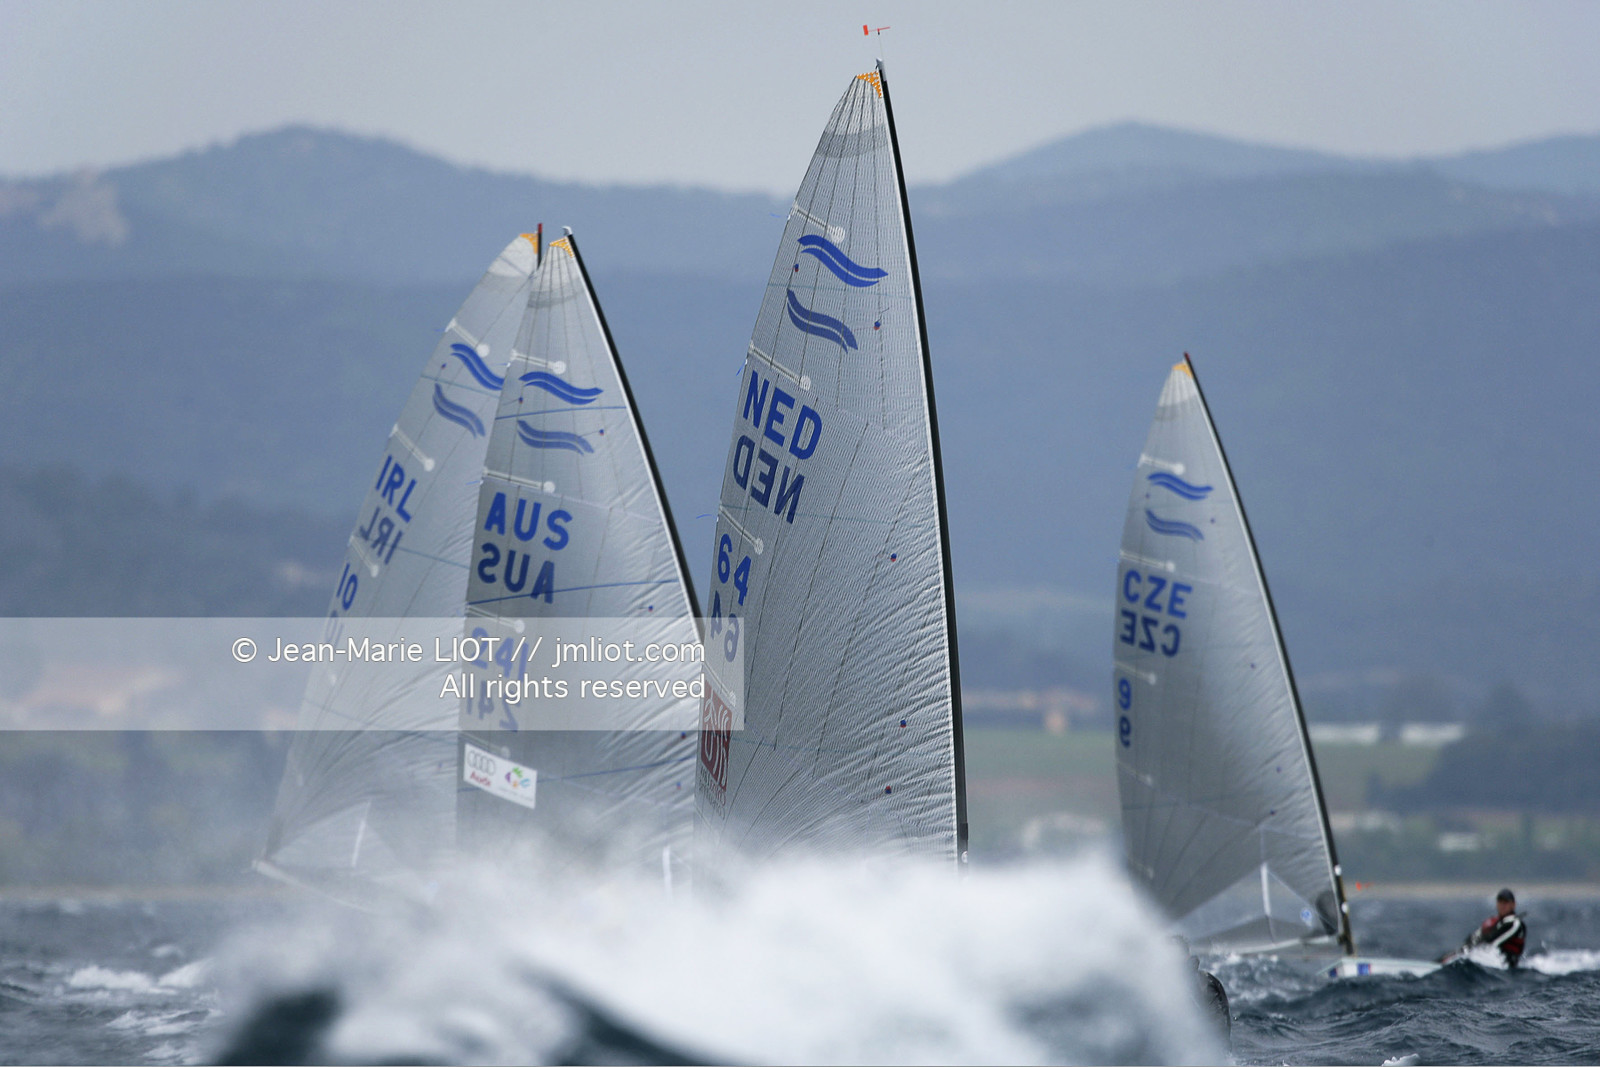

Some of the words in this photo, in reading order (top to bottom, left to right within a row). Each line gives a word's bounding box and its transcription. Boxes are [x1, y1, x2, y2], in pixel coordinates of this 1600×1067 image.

[743, 370, 823, 460] NED
[375, 454, 417, 524] IRL
[484, 491, 573, 551] AUS
[335, 562, 359, 611] 10
[717, 533, 752, 606] 64
[1123, 569, 1193, 619] CZE
[1118, 677, 1132, 711] 9
